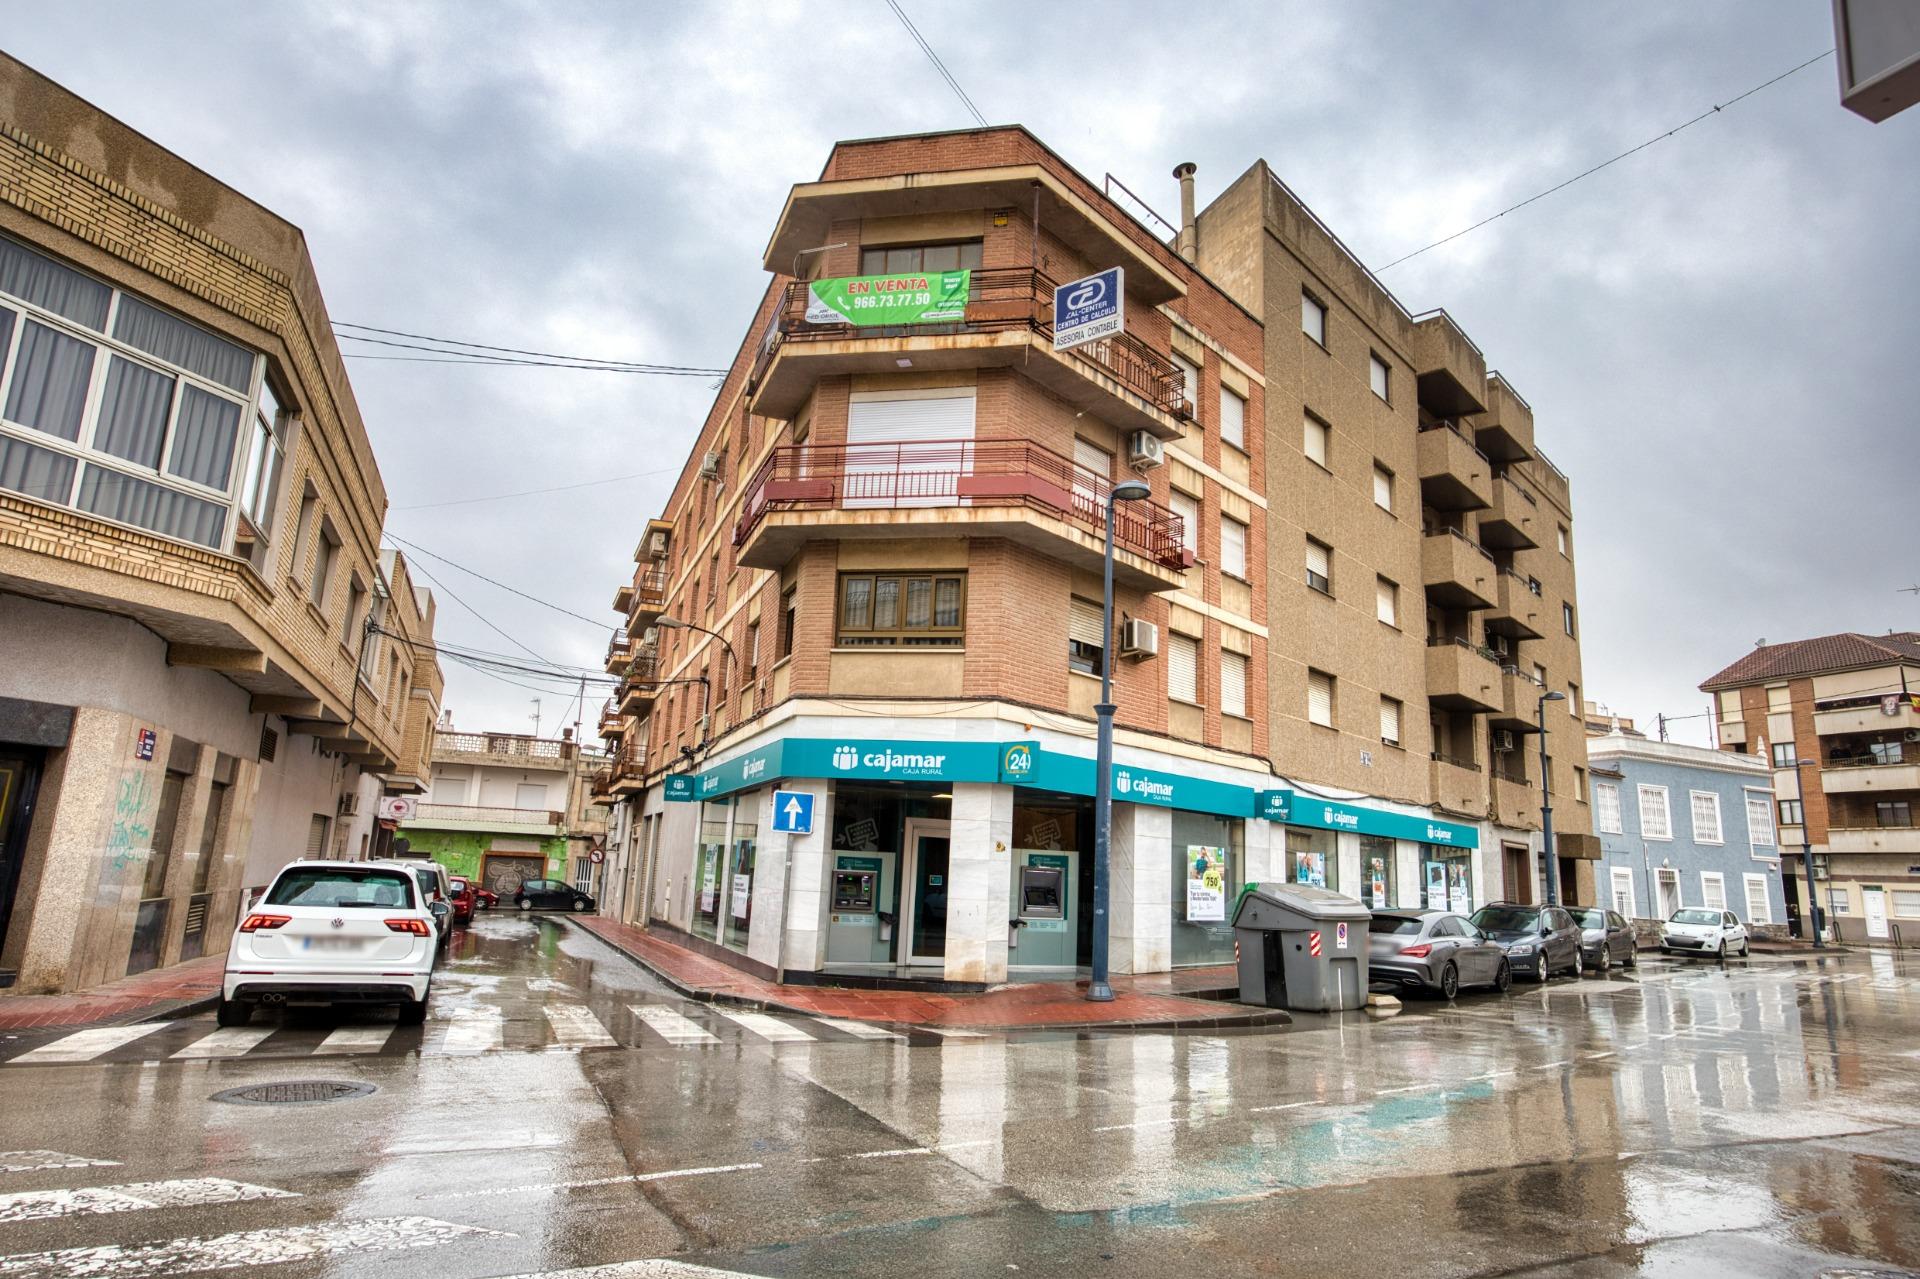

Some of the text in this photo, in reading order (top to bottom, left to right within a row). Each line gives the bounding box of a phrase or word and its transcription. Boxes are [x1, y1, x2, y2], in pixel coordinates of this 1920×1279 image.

[848, 282, 869, 294] EN
[874, 278, 929, 293] VENTA
[854, 292, 931, 309] 966.73.77.50
[1057, 305, 1116, 331] CENTRO DE CALCULO
[1056, 319, 1118, 347] ASESORIA CONTABLE
[863, 749, 946, 773] cajamar
[921, 768, 944, 776] RURAL
[1133, 777, 1173, 797] cajamar
[1264, 807, 1290, 815] cajamar
[1334, 810, 1358, 826] cajamar
